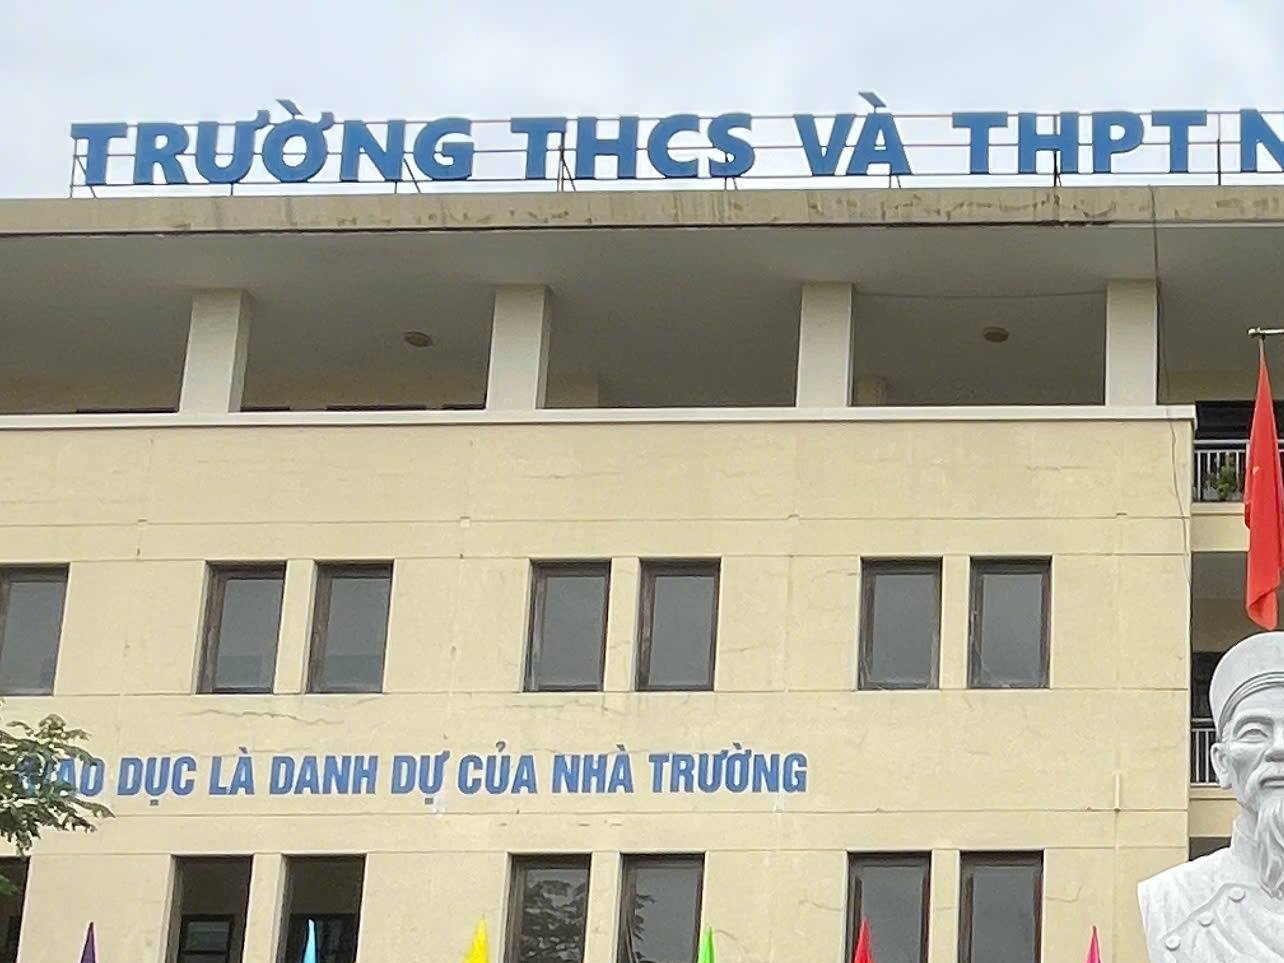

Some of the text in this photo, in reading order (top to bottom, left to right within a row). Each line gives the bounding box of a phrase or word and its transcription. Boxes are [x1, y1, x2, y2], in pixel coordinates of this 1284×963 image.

[71, 98, 473, 185] TRƯỜNG
[511, 113, 756, 181] THCS
[794, 91, 912, 176] VÀ
[953, 109, 1208, 174] THPT
[117, 756, 197, 806] DỤC
[208, 747, 256, 796] LÀ
[269, 755, 379, 795] DANH
[391, 751, 450, 805] DỰ
[458, 741, 538, 795] CỦA
[552, 744, 634, 794] NHÀ
[649, 742, 808, 794] TRƯỜNG
